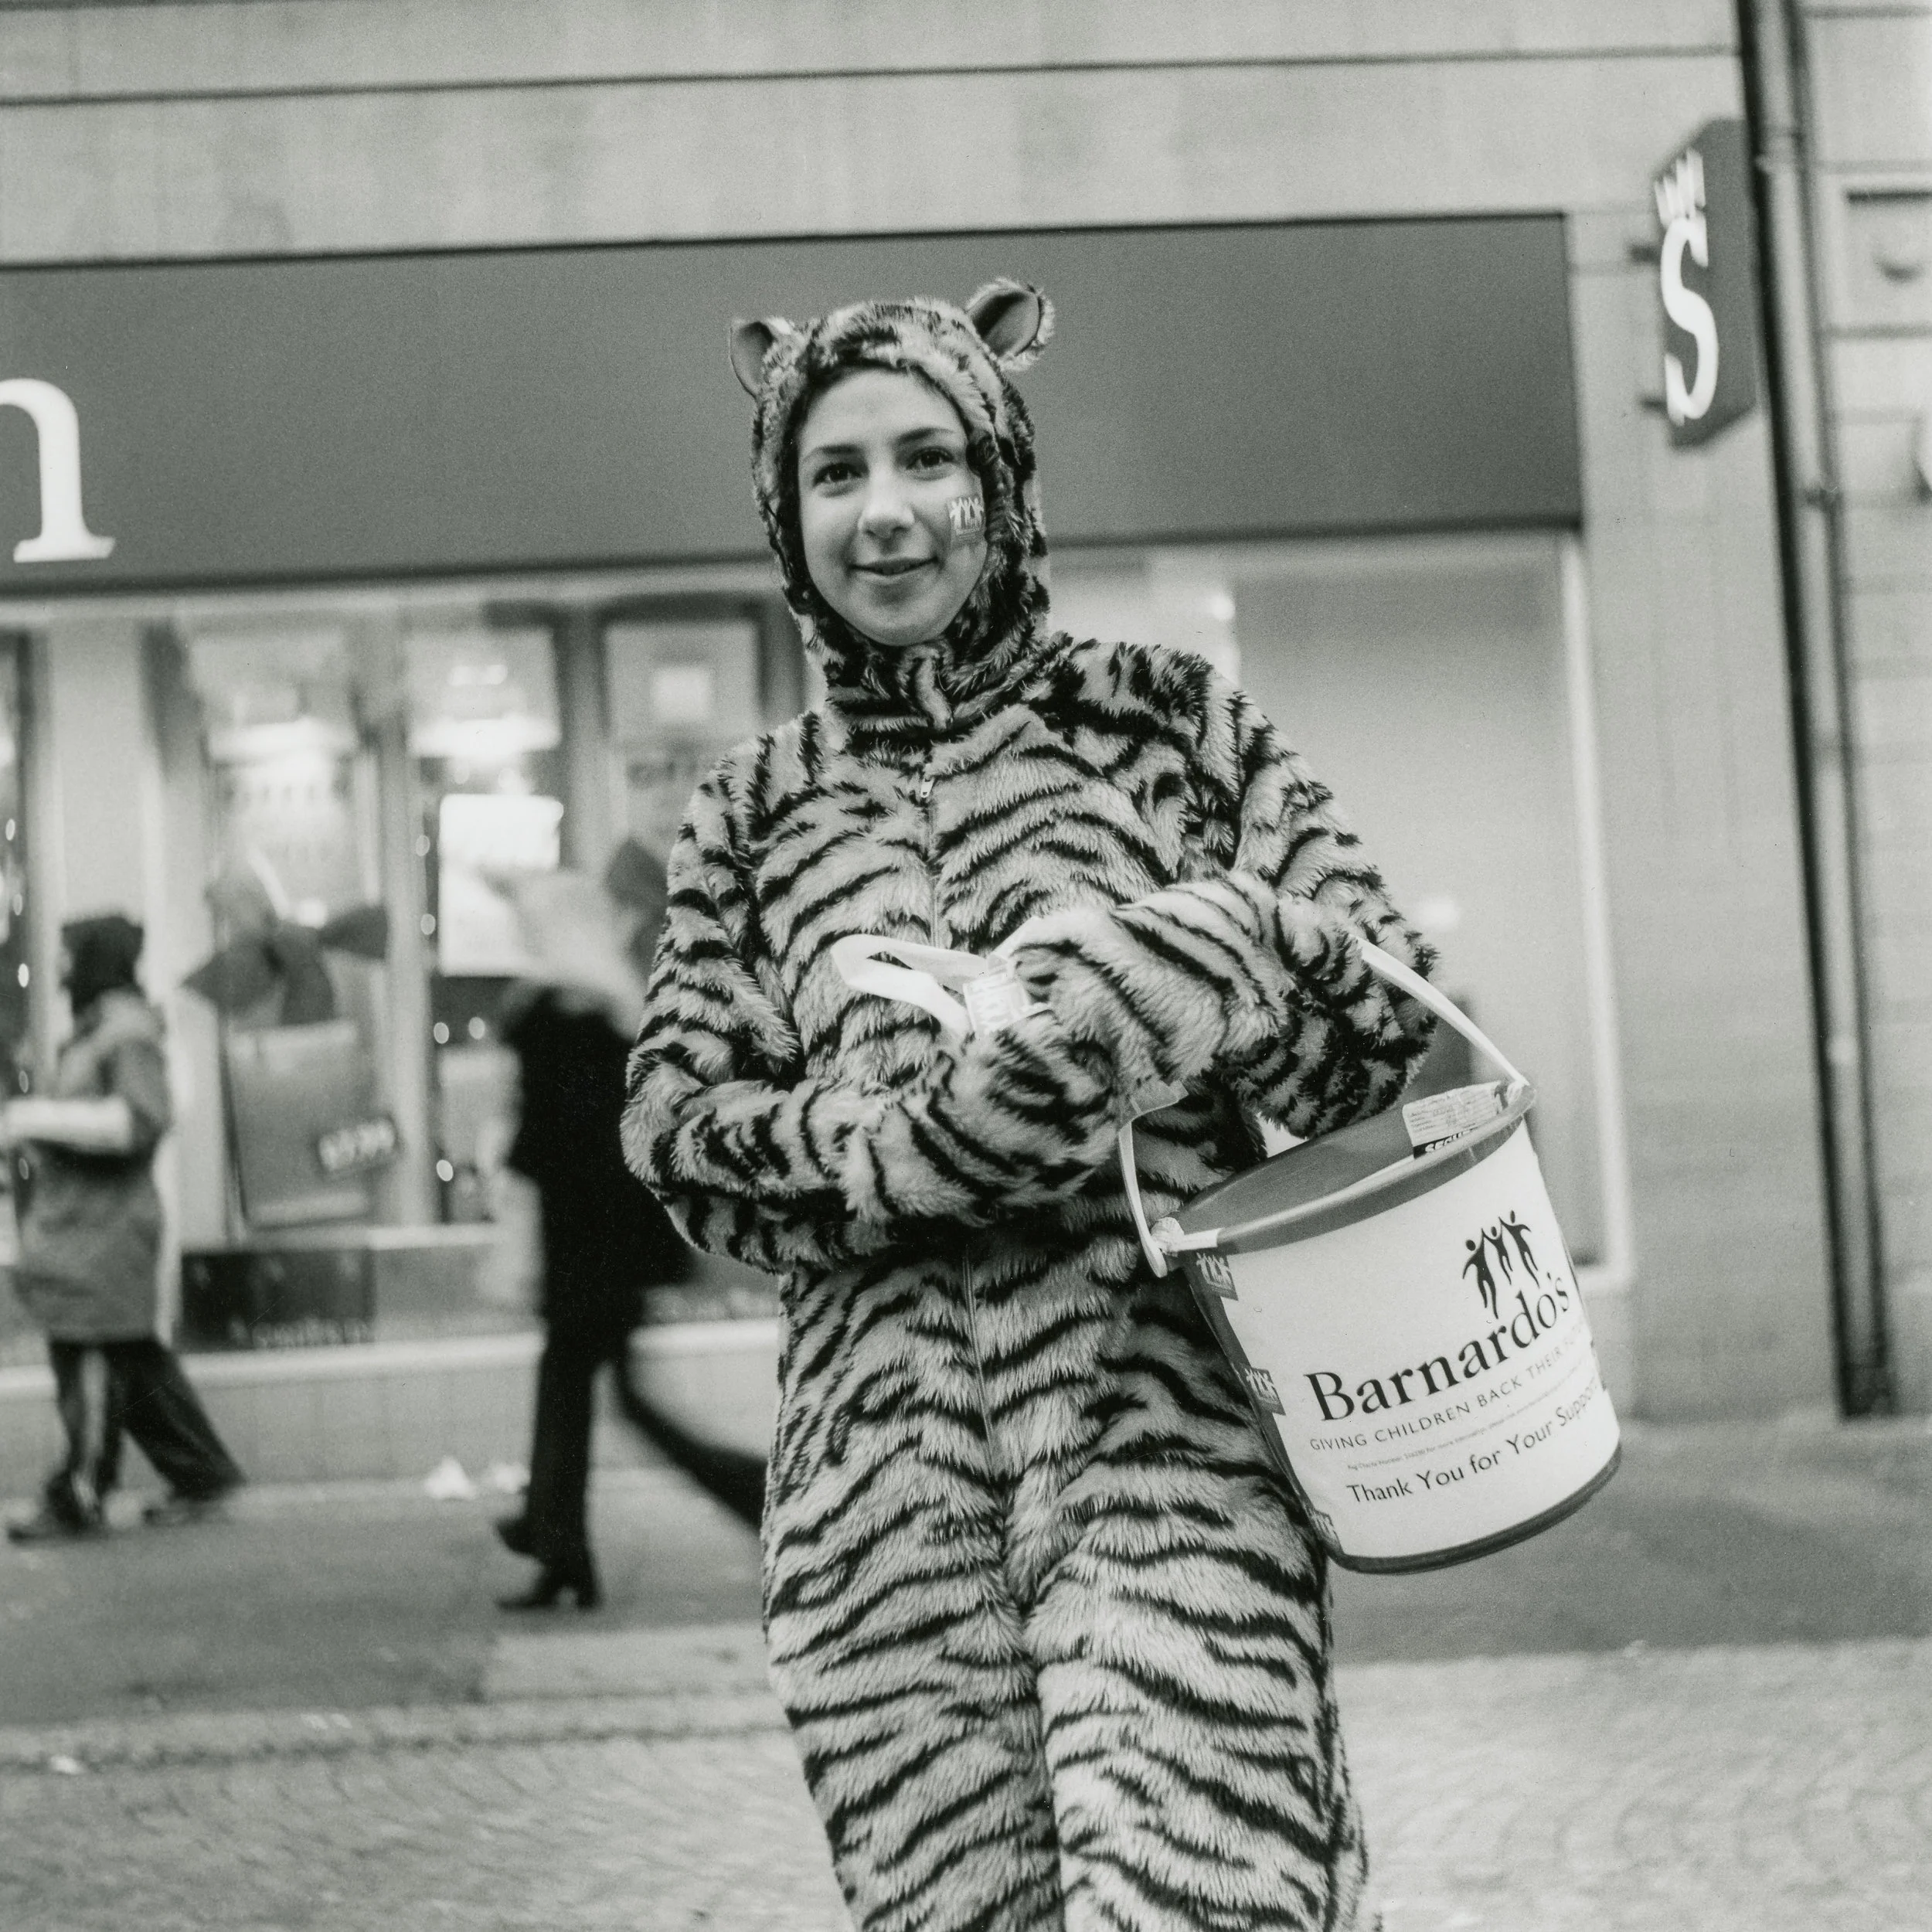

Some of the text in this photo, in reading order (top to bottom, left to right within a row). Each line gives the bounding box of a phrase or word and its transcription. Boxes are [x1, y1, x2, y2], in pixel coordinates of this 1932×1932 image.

[1303, 1271, 1570, 1422] Barnardo's
[1310, 1433, 1367, 1451] GIVING
[1375, 1402, 1471, 1442] CHILDREN
[1477, 1375, 1522, 1407] BACK
[1526, 1346, 1563, 1379] THEIR
[1345, 1478, 1413, 1502] Thank
[1416, 1467, 1464, 1490] You
[1470, 1450, 1501, 1474] for
[1505, 1420, 1553, 1454] Your
[1556, 1376, 1597, 1427] Suppo
